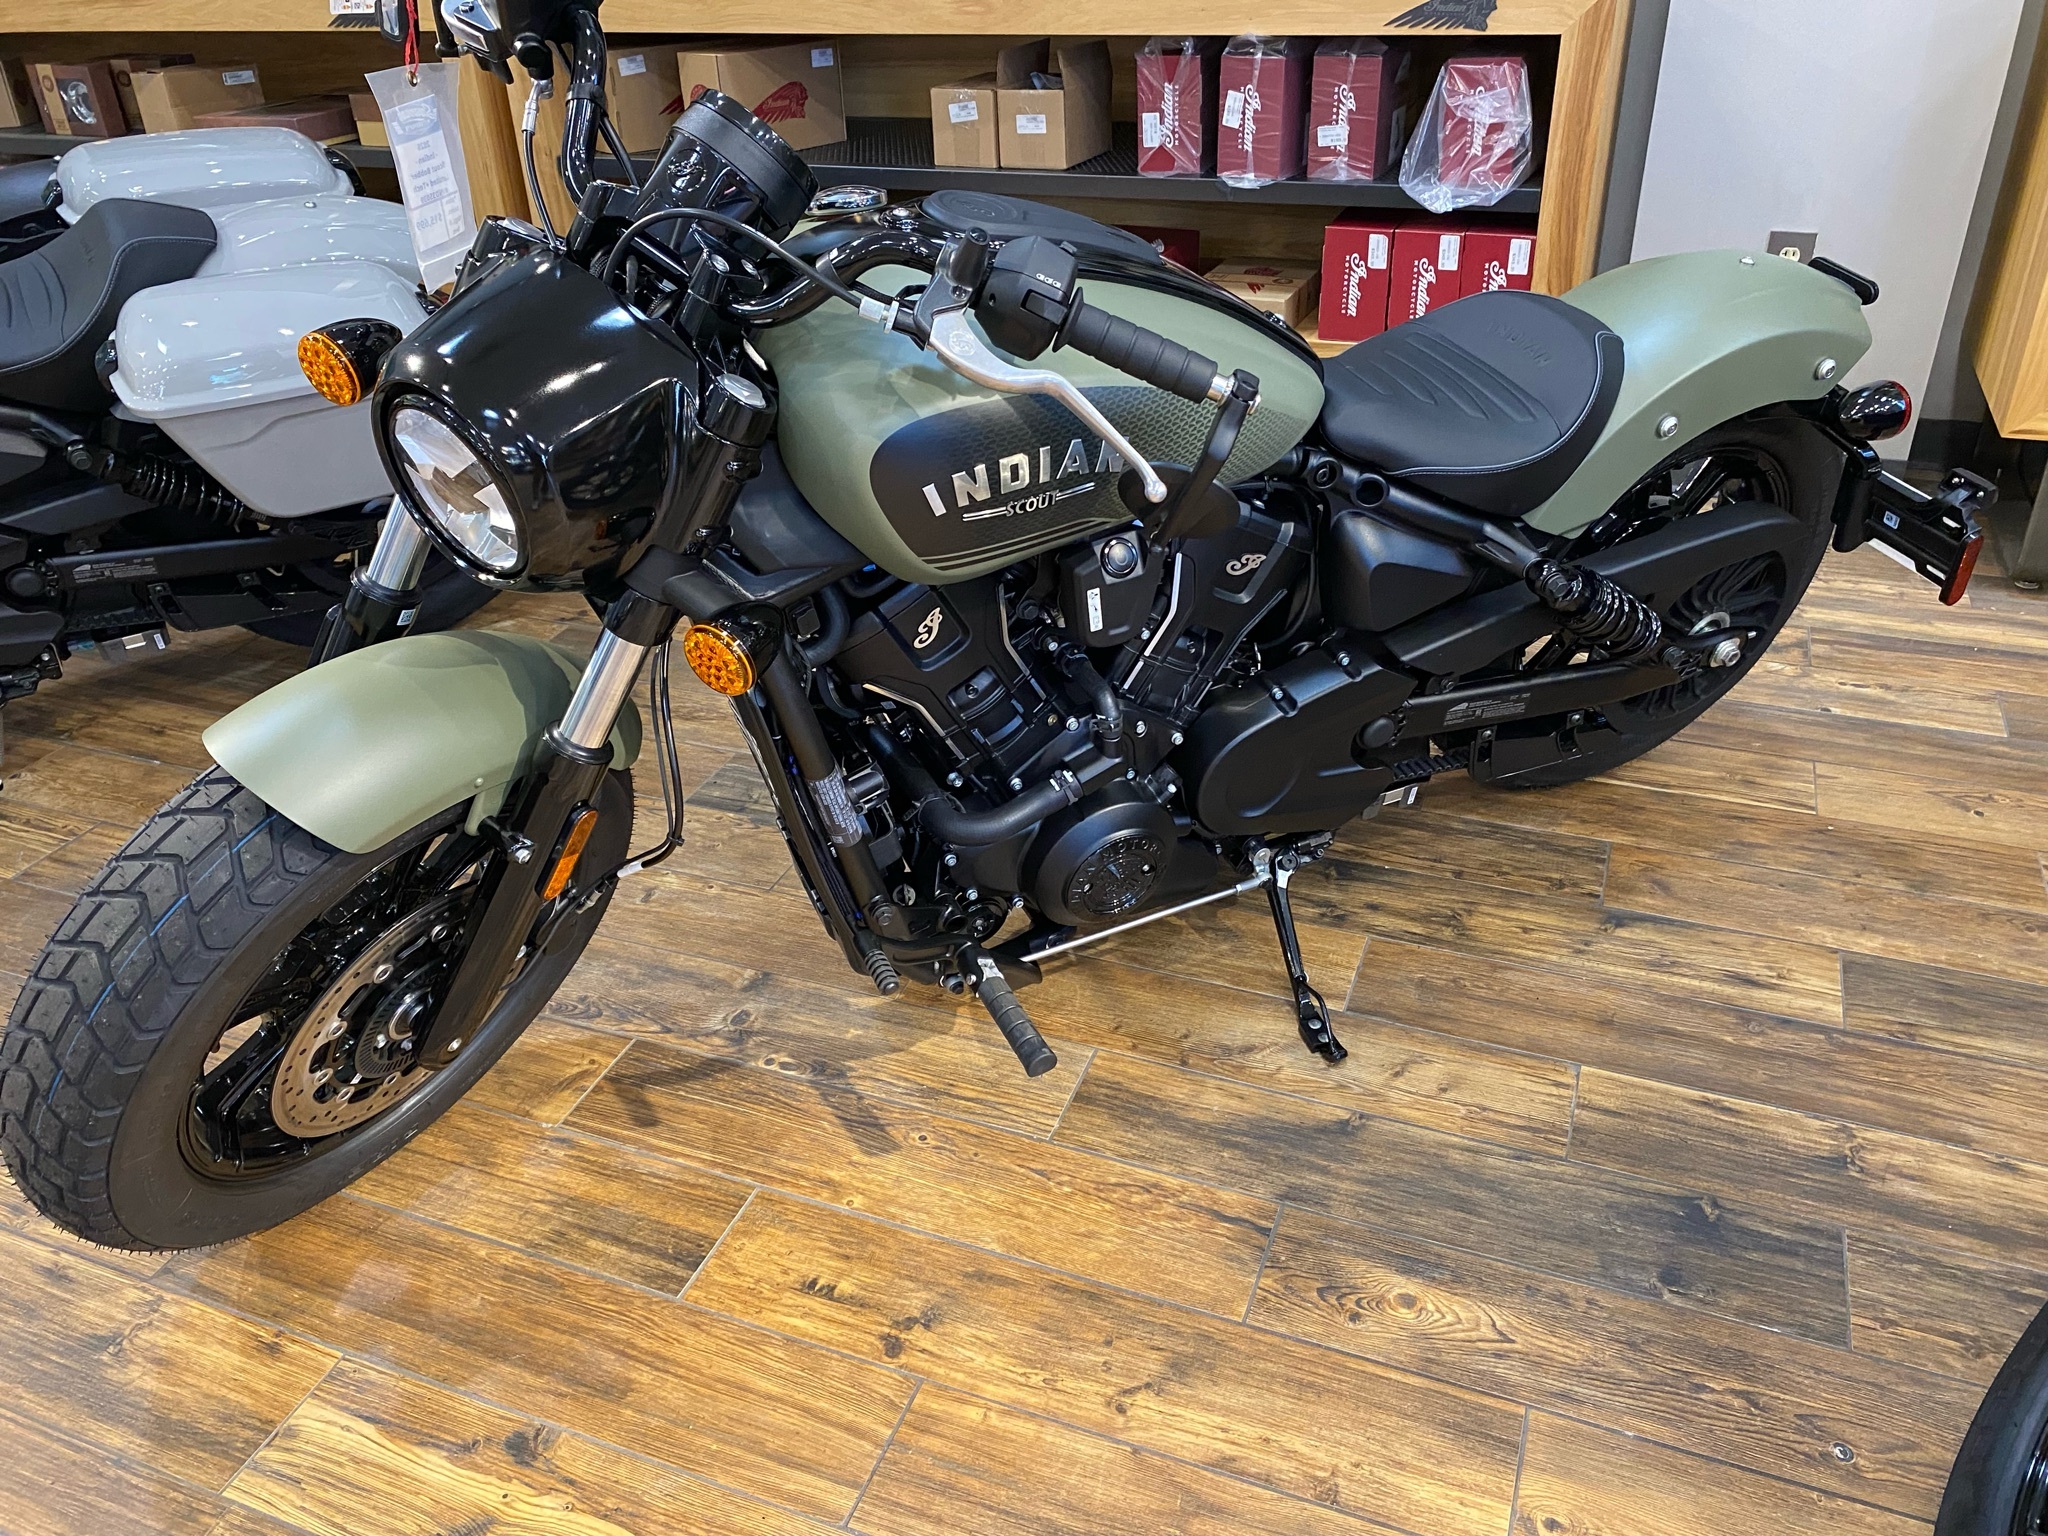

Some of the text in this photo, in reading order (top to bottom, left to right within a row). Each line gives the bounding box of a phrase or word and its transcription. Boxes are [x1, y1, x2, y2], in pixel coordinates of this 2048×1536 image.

[1160, 82, 1174, 148] Indian
[1243, 84, 1261, 152] Indian
[1341, 255, 1350, 314] MOTORCYCLE
[1347, 253, 1367, 317] Indian
[1005, 489, 1061, 517] SCOUT
